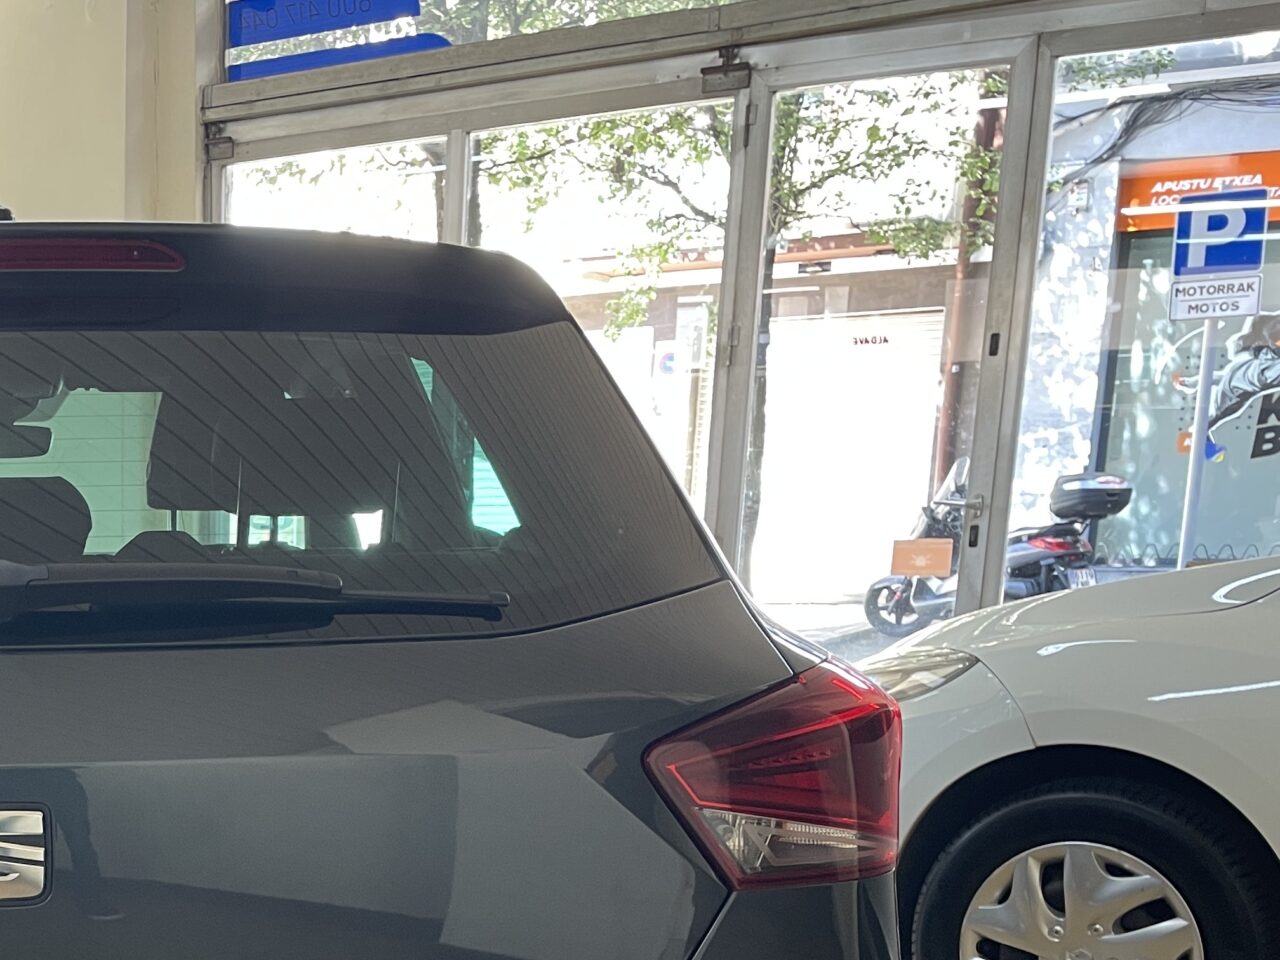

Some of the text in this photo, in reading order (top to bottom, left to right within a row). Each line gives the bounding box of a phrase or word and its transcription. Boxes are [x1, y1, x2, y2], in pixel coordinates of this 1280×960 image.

[1150, 177, 1211, 194] APUSTU
[1187, 207, 1247, 269] P
[1175, 281, 1256, 298] MOTORRAK
[1187, 300, 1240, 315] MOTOS
